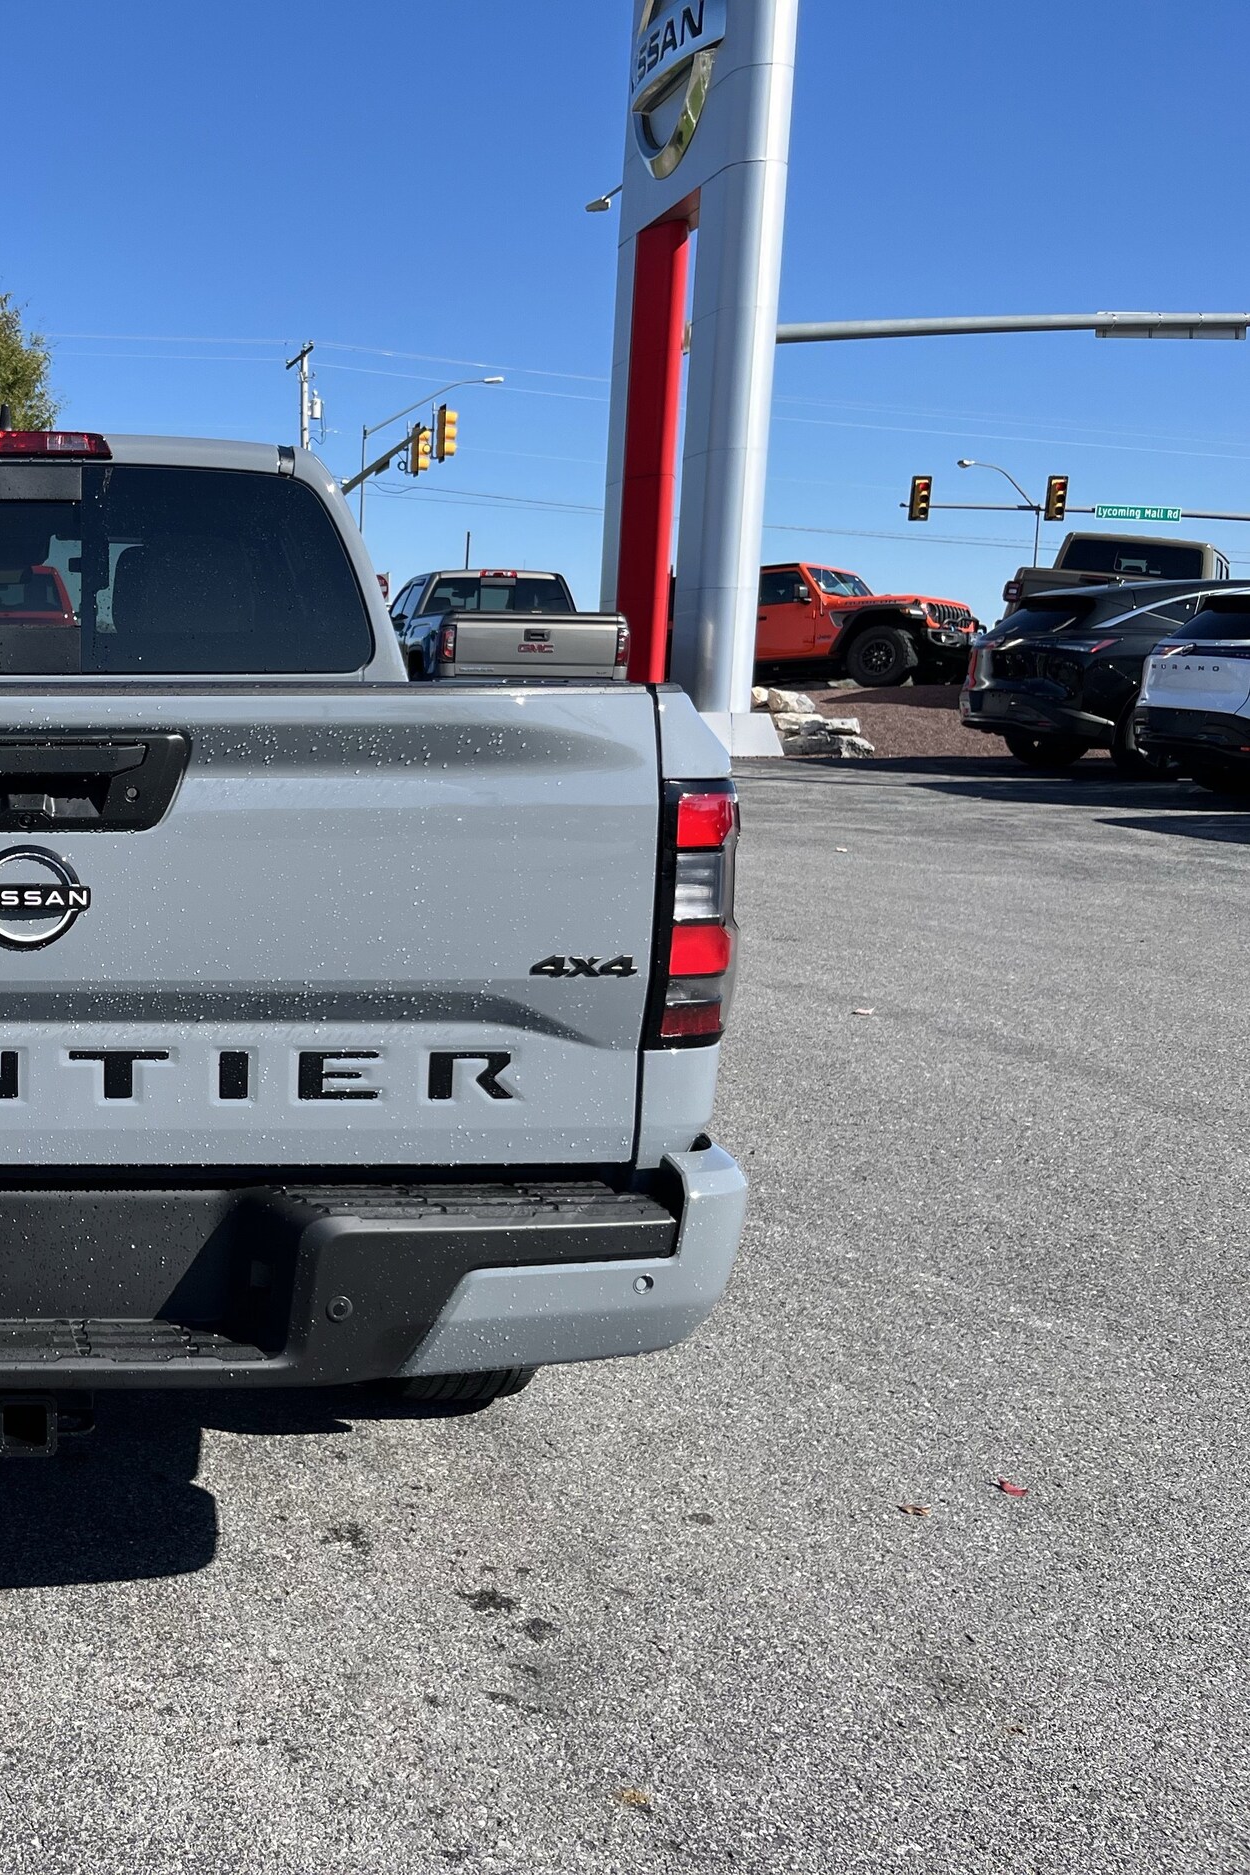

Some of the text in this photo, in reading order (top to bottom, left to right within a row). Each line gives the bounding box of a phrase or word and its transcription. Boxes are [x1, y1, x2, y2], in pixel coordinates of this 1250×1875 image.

[1098, 507, 1179, 520] Lycoming Mall Rd
[518, 644, 554, 654] GMC
[1151, 663, 1220, 672] MURANO
